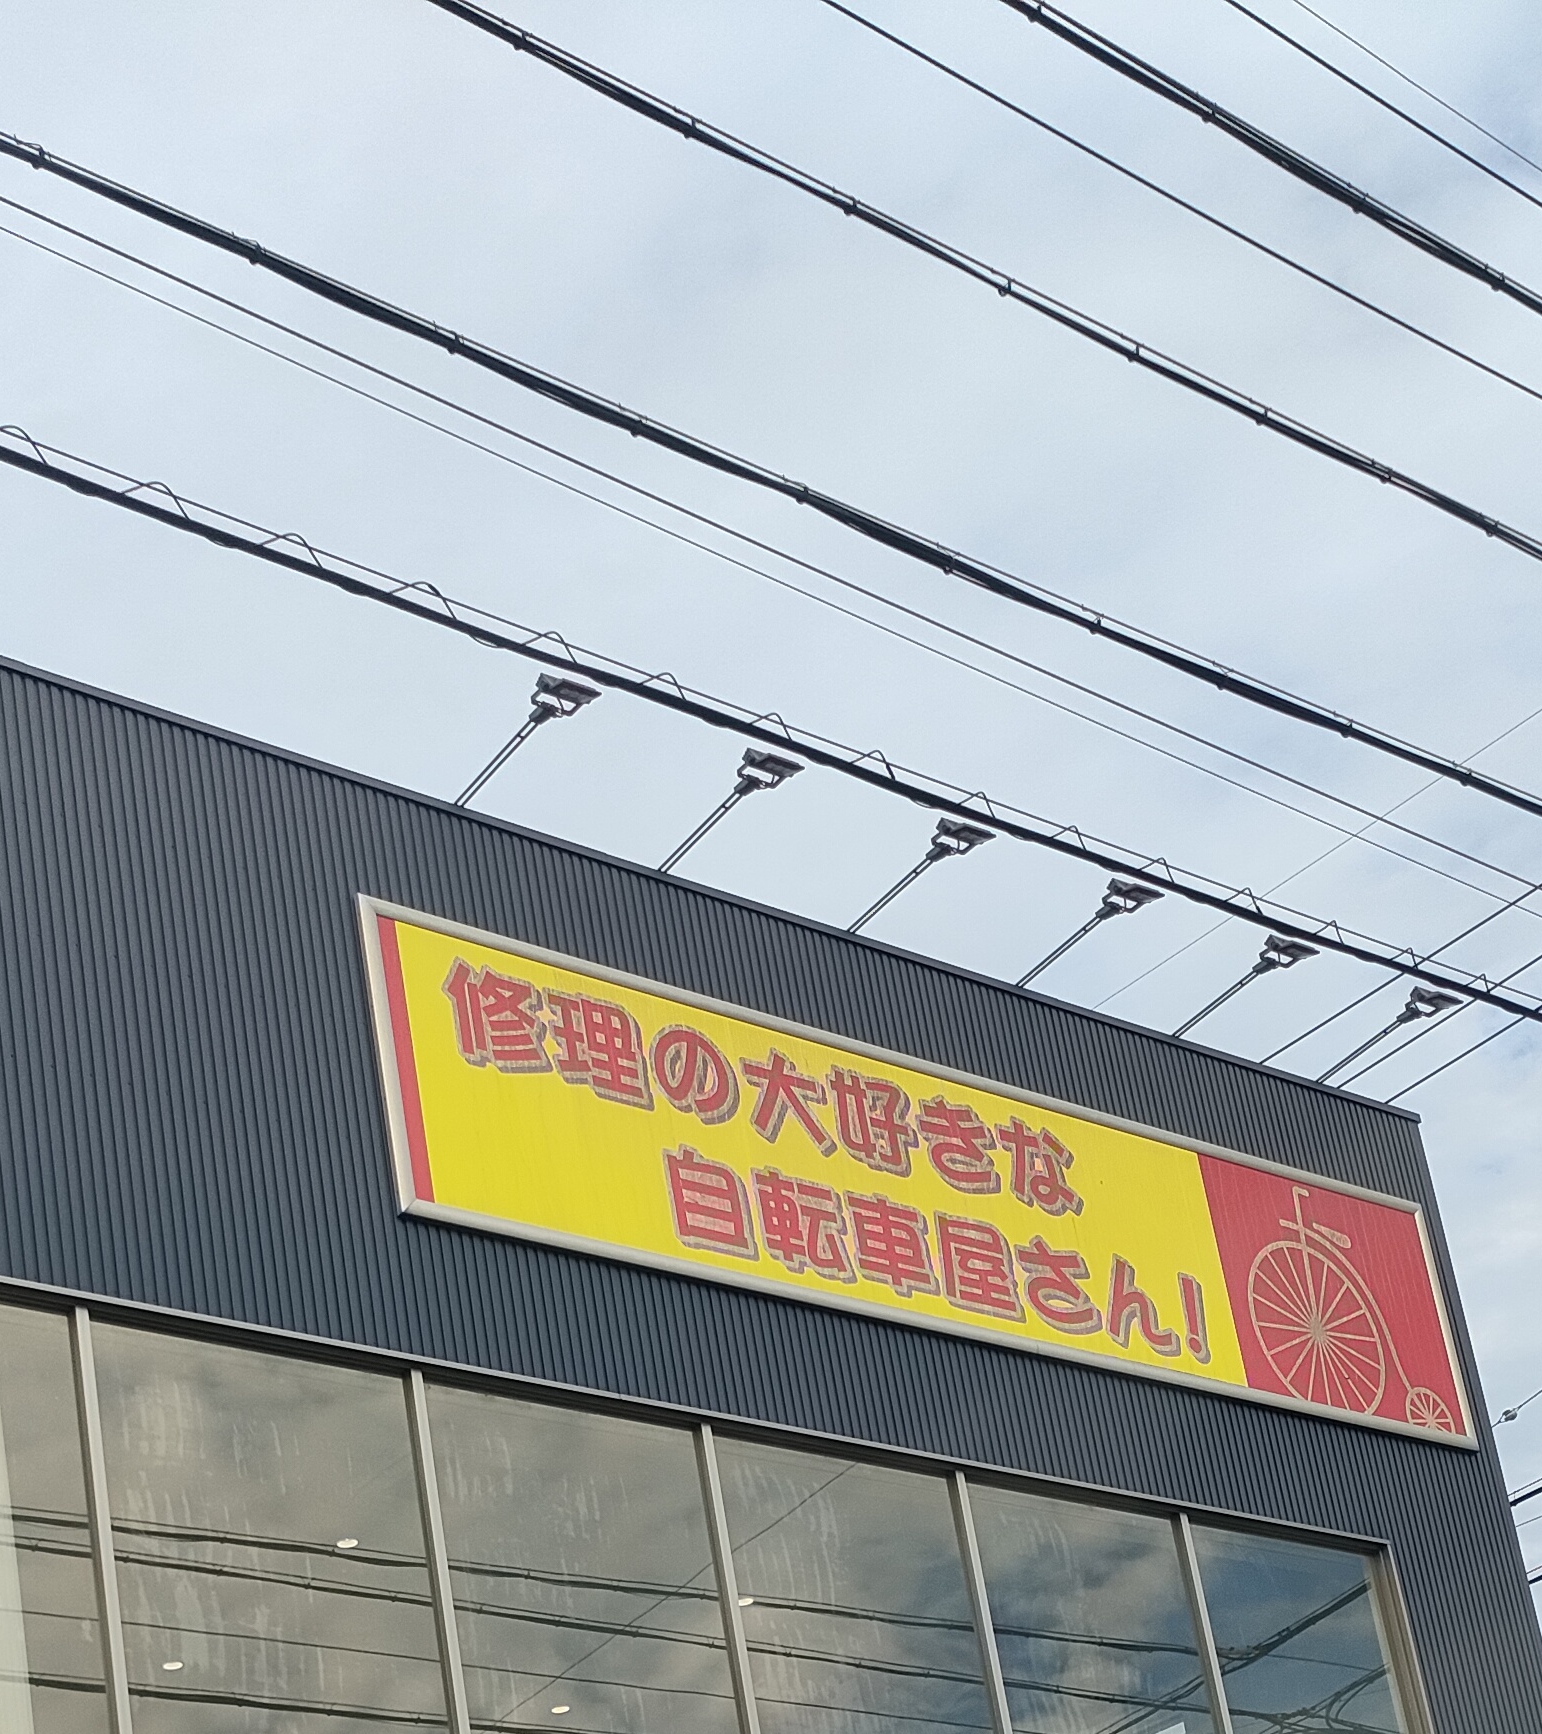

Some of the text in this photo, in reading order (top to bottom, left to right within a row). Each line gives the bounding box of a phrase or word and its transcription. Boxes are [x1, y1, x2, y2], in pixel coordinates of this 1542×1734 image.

[441, 957, 1085, 1217] 修理の大好きな
